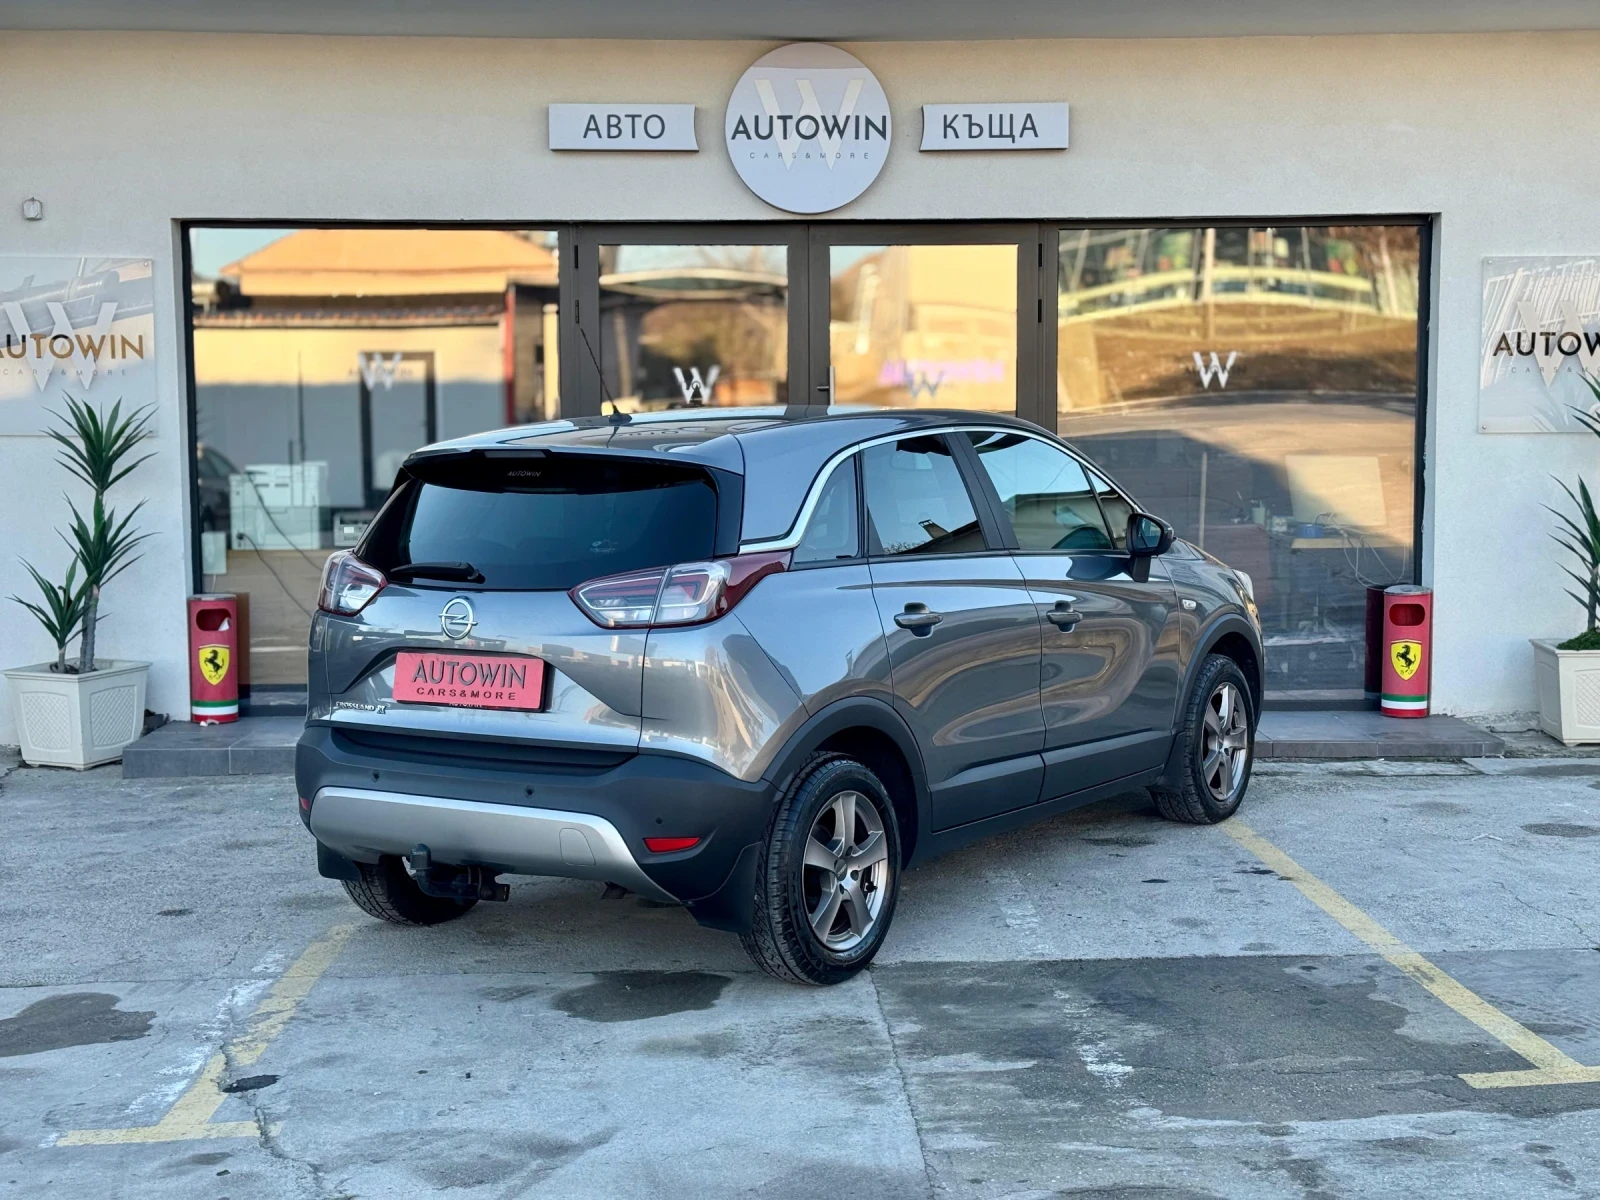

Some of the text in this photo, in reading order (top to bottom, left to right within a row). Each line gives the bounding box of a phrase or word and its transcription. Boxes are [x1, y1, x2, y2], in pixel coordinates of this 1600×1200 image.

[582, 114, 666, 139] АВТО
[731, 114, 887, 141] AUTOWIN
[943, 113, 1039, 144] КЪЩА
[749, 152, 869, 160] CARS&MORE
[0, 333, 144, 360] UTOWIN
[2, 368, 127, 376] CARS&MORE
[412, 659, 527, 689] AUTOWIN
[416, 687, 516, 701] CARS&MORE
